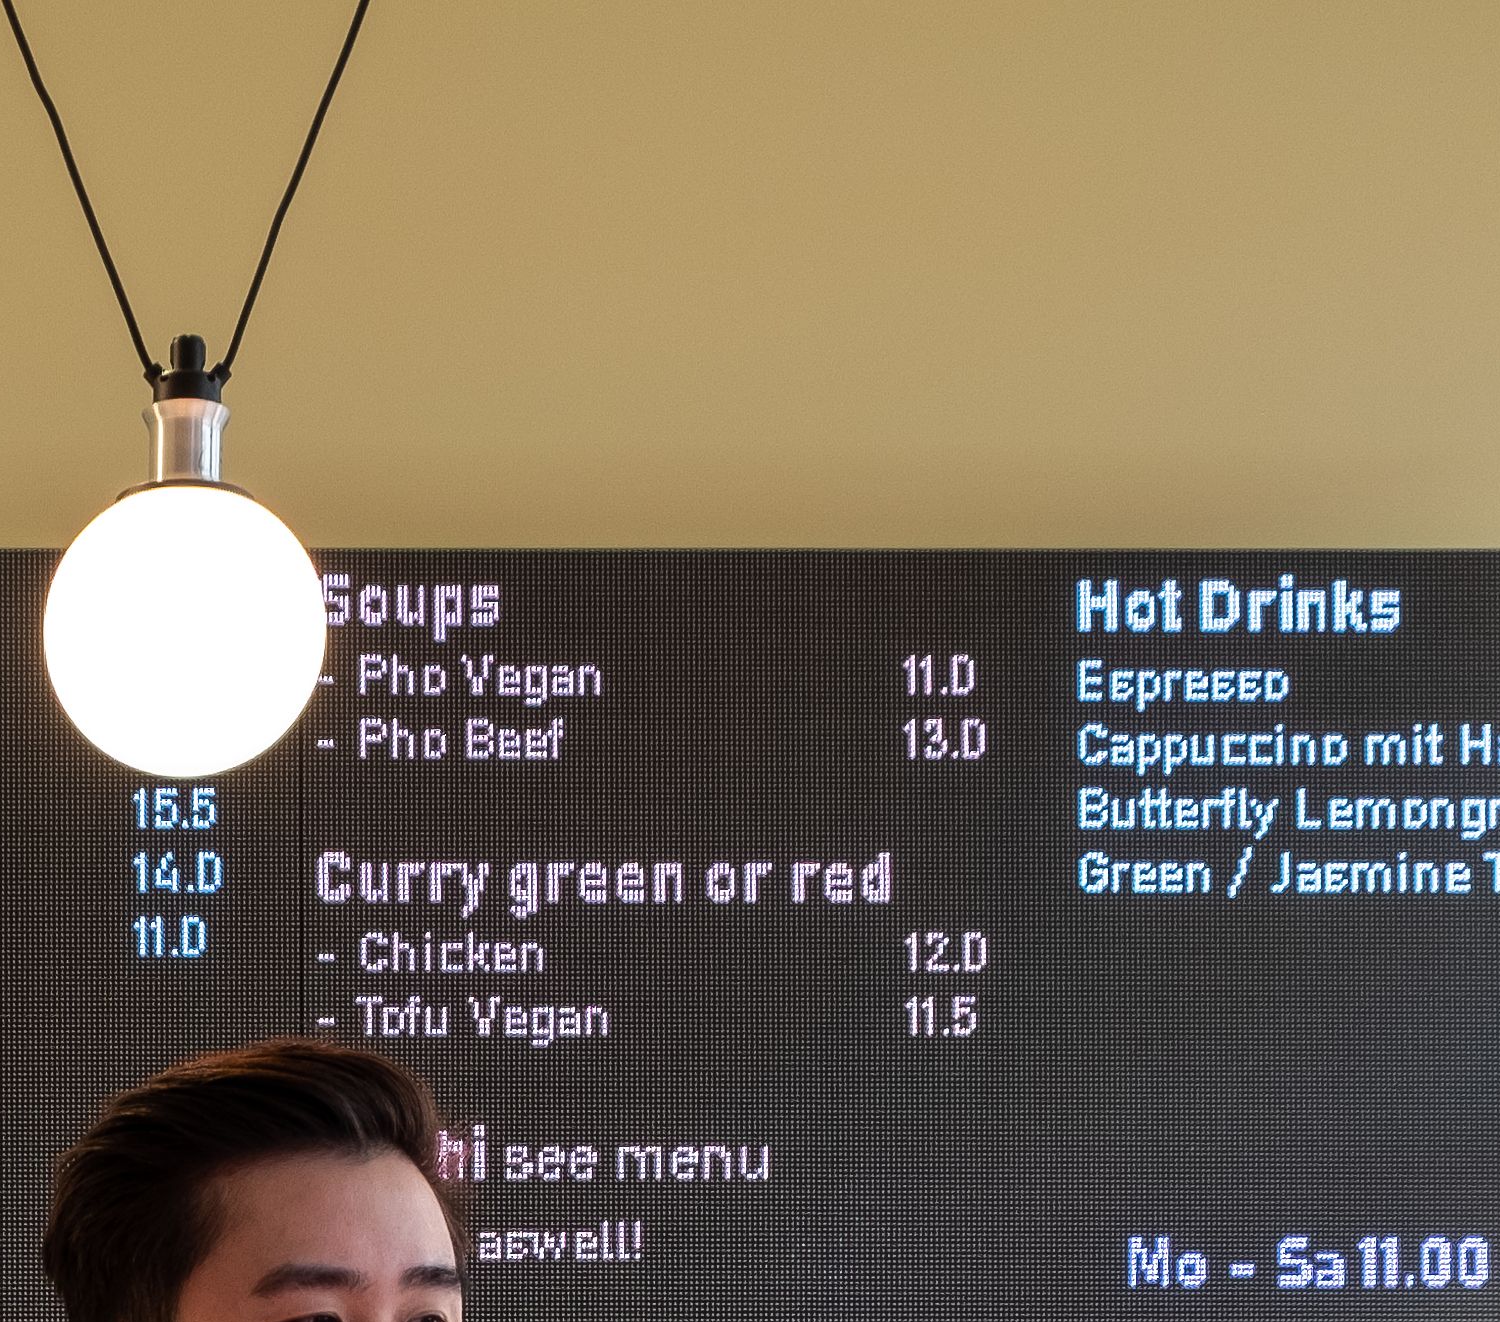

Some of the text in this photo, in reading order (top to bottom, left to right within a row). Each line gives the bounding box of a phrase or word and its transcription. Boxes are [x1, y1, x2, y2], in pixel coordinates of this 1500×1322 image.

[332, 574, 499, 641] Soups
[1077, 574, 1401, 633] Hot Drinks
[359, 654, 446, 695] Pho
[461, 655, 601, 705] Vegan
[903, 655, 975, 695] 11.0
[1077, 659, 1289, 712] Espresso
[360, 718, 446, 758] Pho
[466, 719, 564, 759] Beef
[903, 718, 986, 759] 13.0
[1078, 723, 1348, 776] Cappuccino
[1364, 723, 1444, 766] mit
[133, 787, 216, 829] 15.5
[1078, 787, 1279, 840] Butterfly
[133, 851, 222, 894] 14.0
[318, 851, 891, 918] Curry green or red
[1078, 851, 1211, 894] Green
[1270, 851, 1472, 894] Jasmine
[133, 915, 206, 957] 11.0
[361, 932, 543, 972] Chicken
[905, 932, 987, 972] 12.0
[356, 996, 447, 1035] Tofu
[468, 996, 608, 1046] Vegan
[905, 996, 977, 1036] 11.5
[506, 1146, 598, 1180] see
[618, 1145, 769, 1180] menu
[479, 1221, 641, 1260] aswell!
[1127, 1236, 1207, 1289] Mo
[1276, 1235, 1346, 1289] Sa
[1357, 1235, 1490, 1289] 11.00
